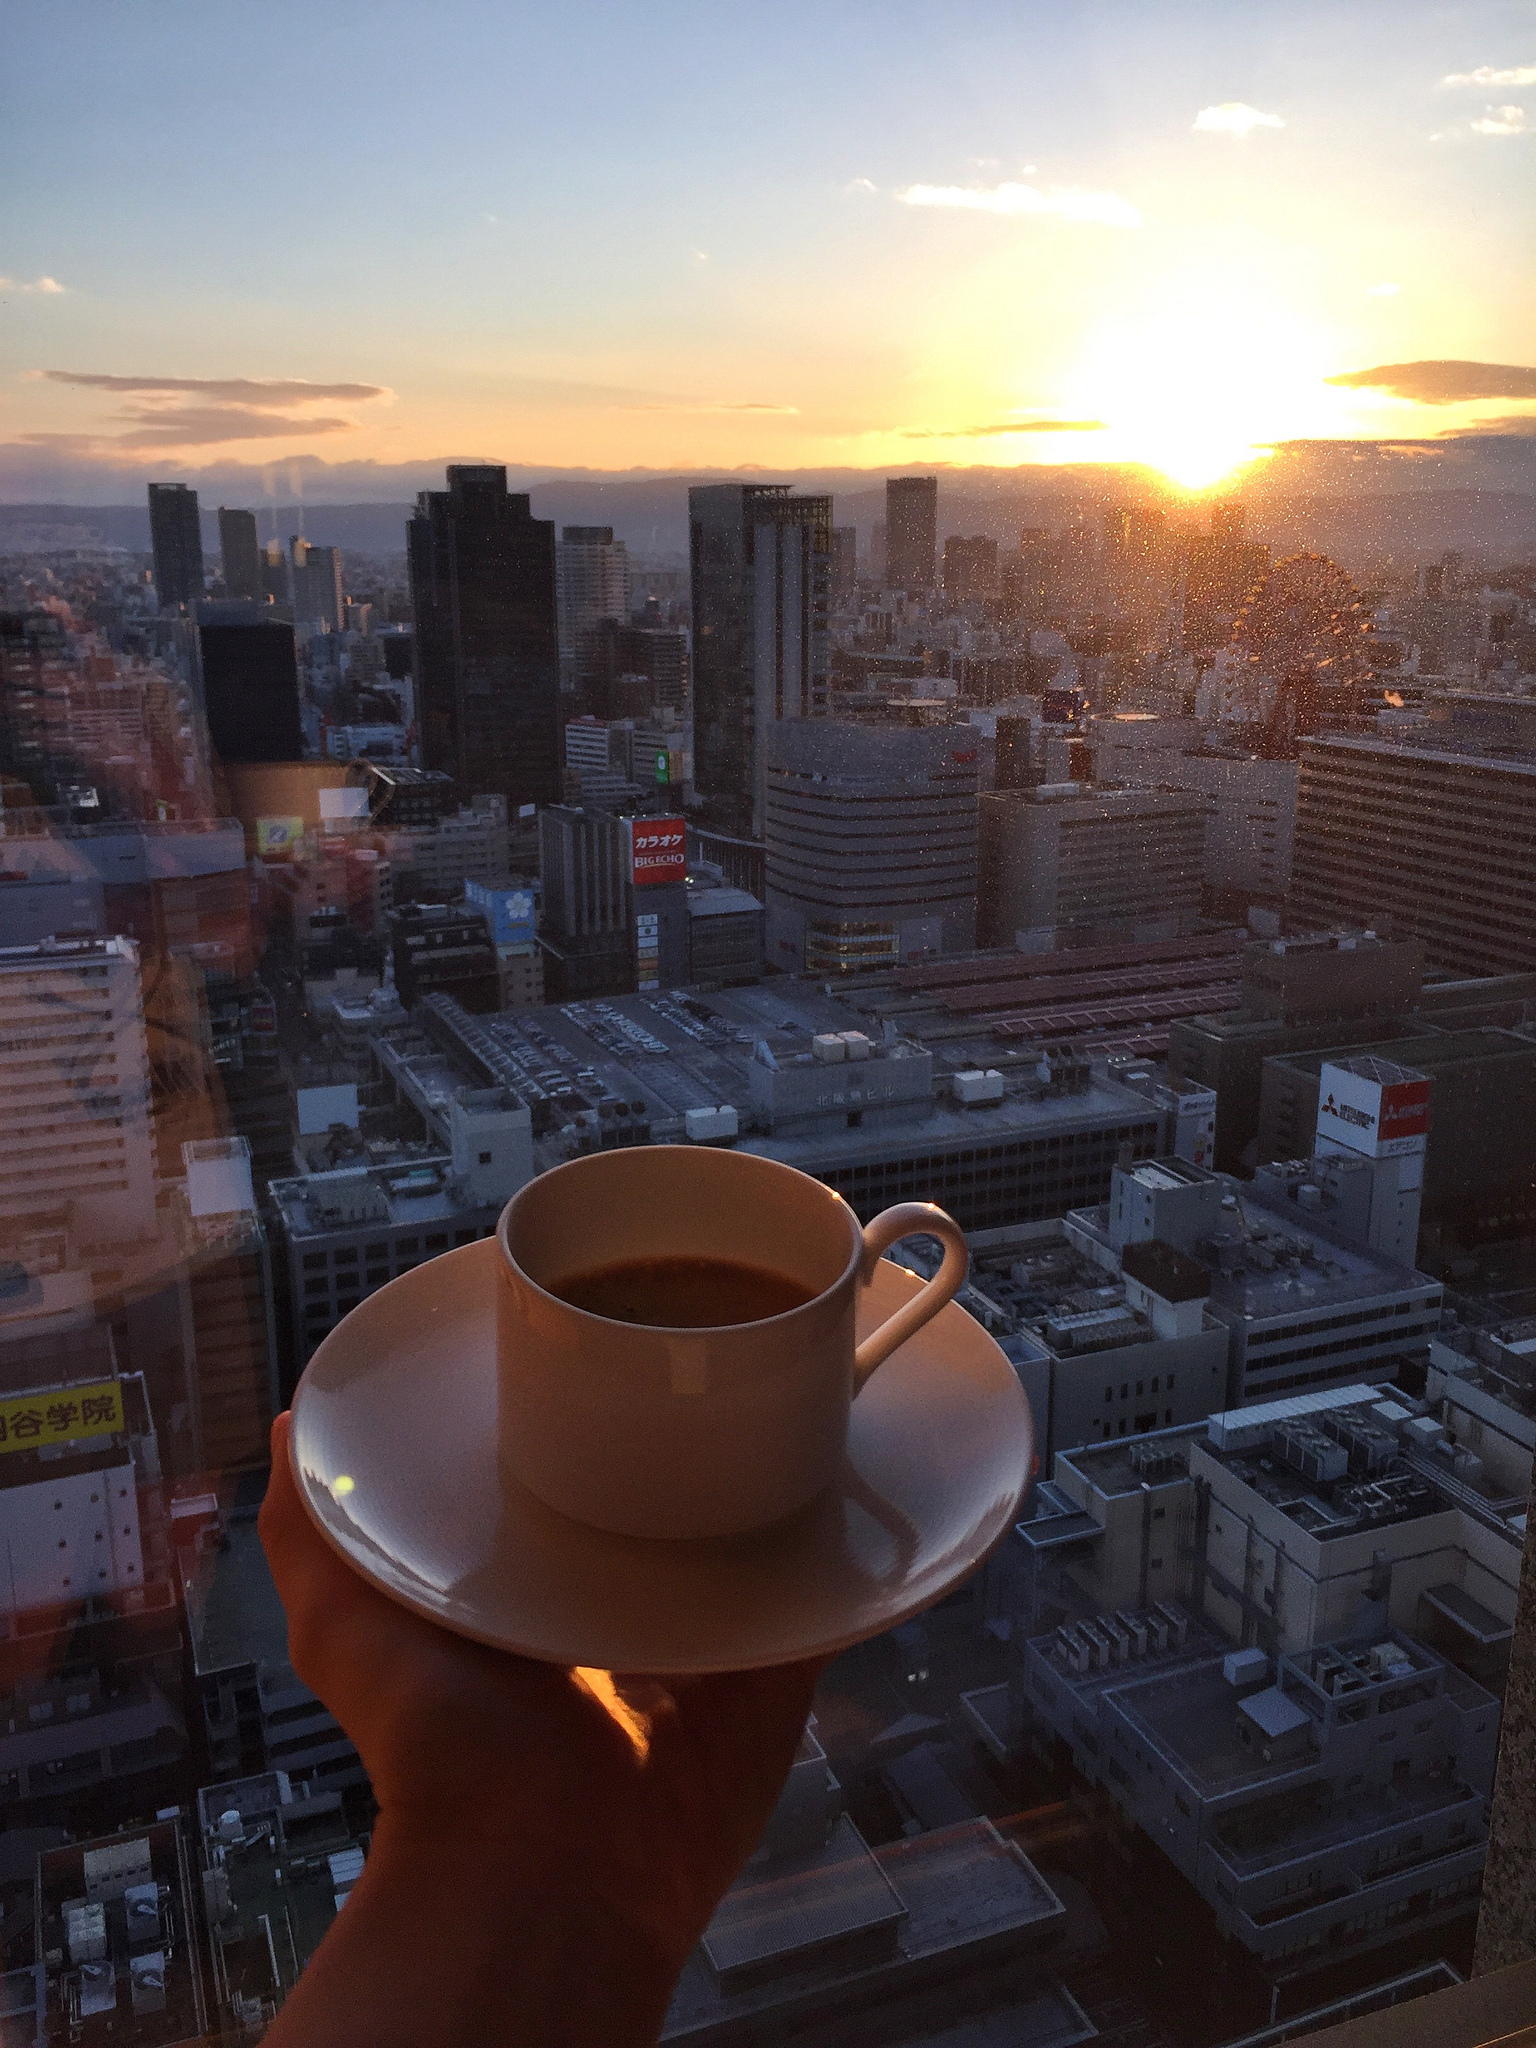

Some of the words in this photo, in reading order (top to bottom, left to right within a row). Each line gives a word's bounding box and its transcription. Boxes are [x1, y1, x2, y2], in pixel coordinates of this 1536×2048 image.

[635, 834, 683, 849] カラオケ
[634, 856, 655, 868] BIG
[656, 853, 685, 865] ECHO
[0, 1395, 116, 1442] 谷学院
